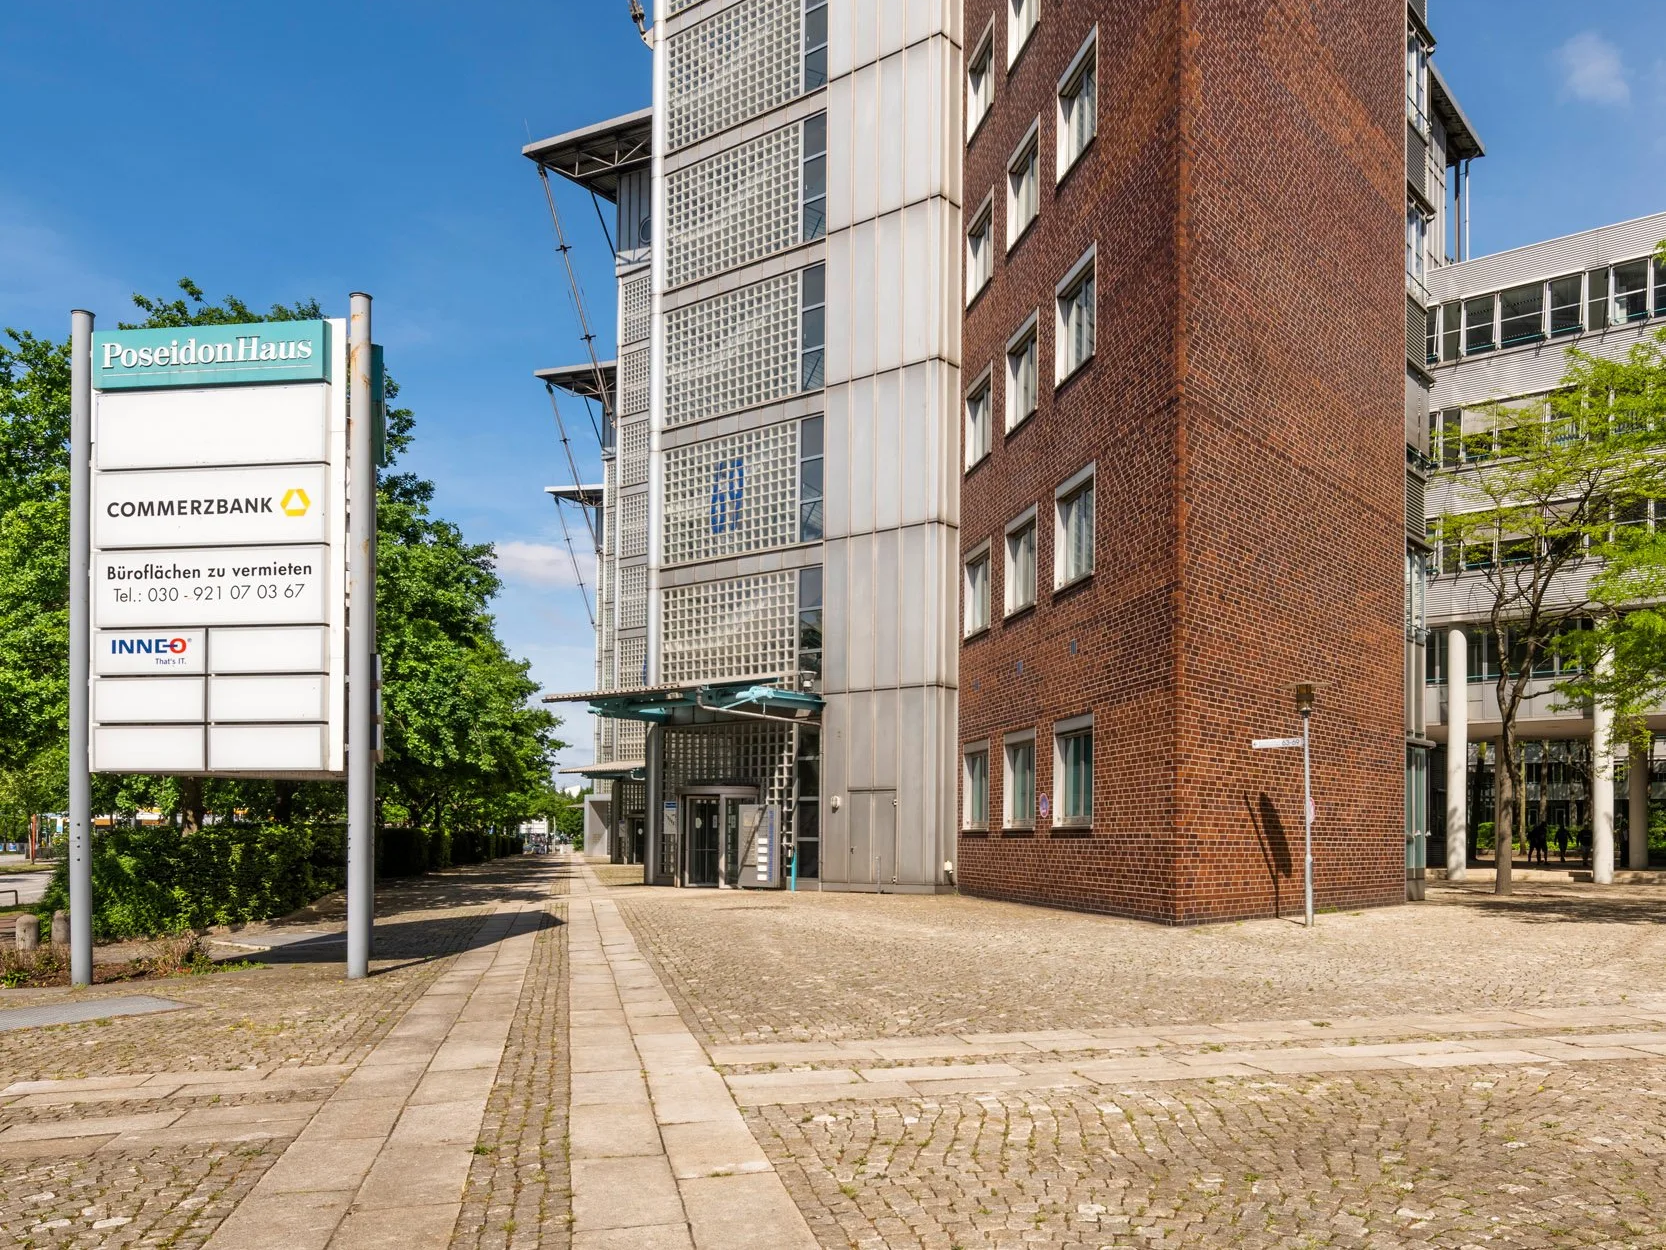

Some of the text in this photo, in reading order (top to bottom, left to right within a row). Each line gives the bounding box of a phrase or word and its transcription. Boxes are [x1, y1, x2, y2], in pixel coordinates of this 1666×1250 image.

[102, 336, 312, 368] PoseidonHaus
[107, 497, 273, 518] COMMERZBANK
[107, 562, 312, 580] Büroflächen zu vermieten
[114, 587, 142, 602] Tel.:
[148, 587, 179, 602] 030
[193, 585, 222, 600] 921
[230, 584, 251, 599] 07
[257, 584, 277, 599] 03
[284, 583, 305, 598] 67
[155, 657, 176, 665] That's
